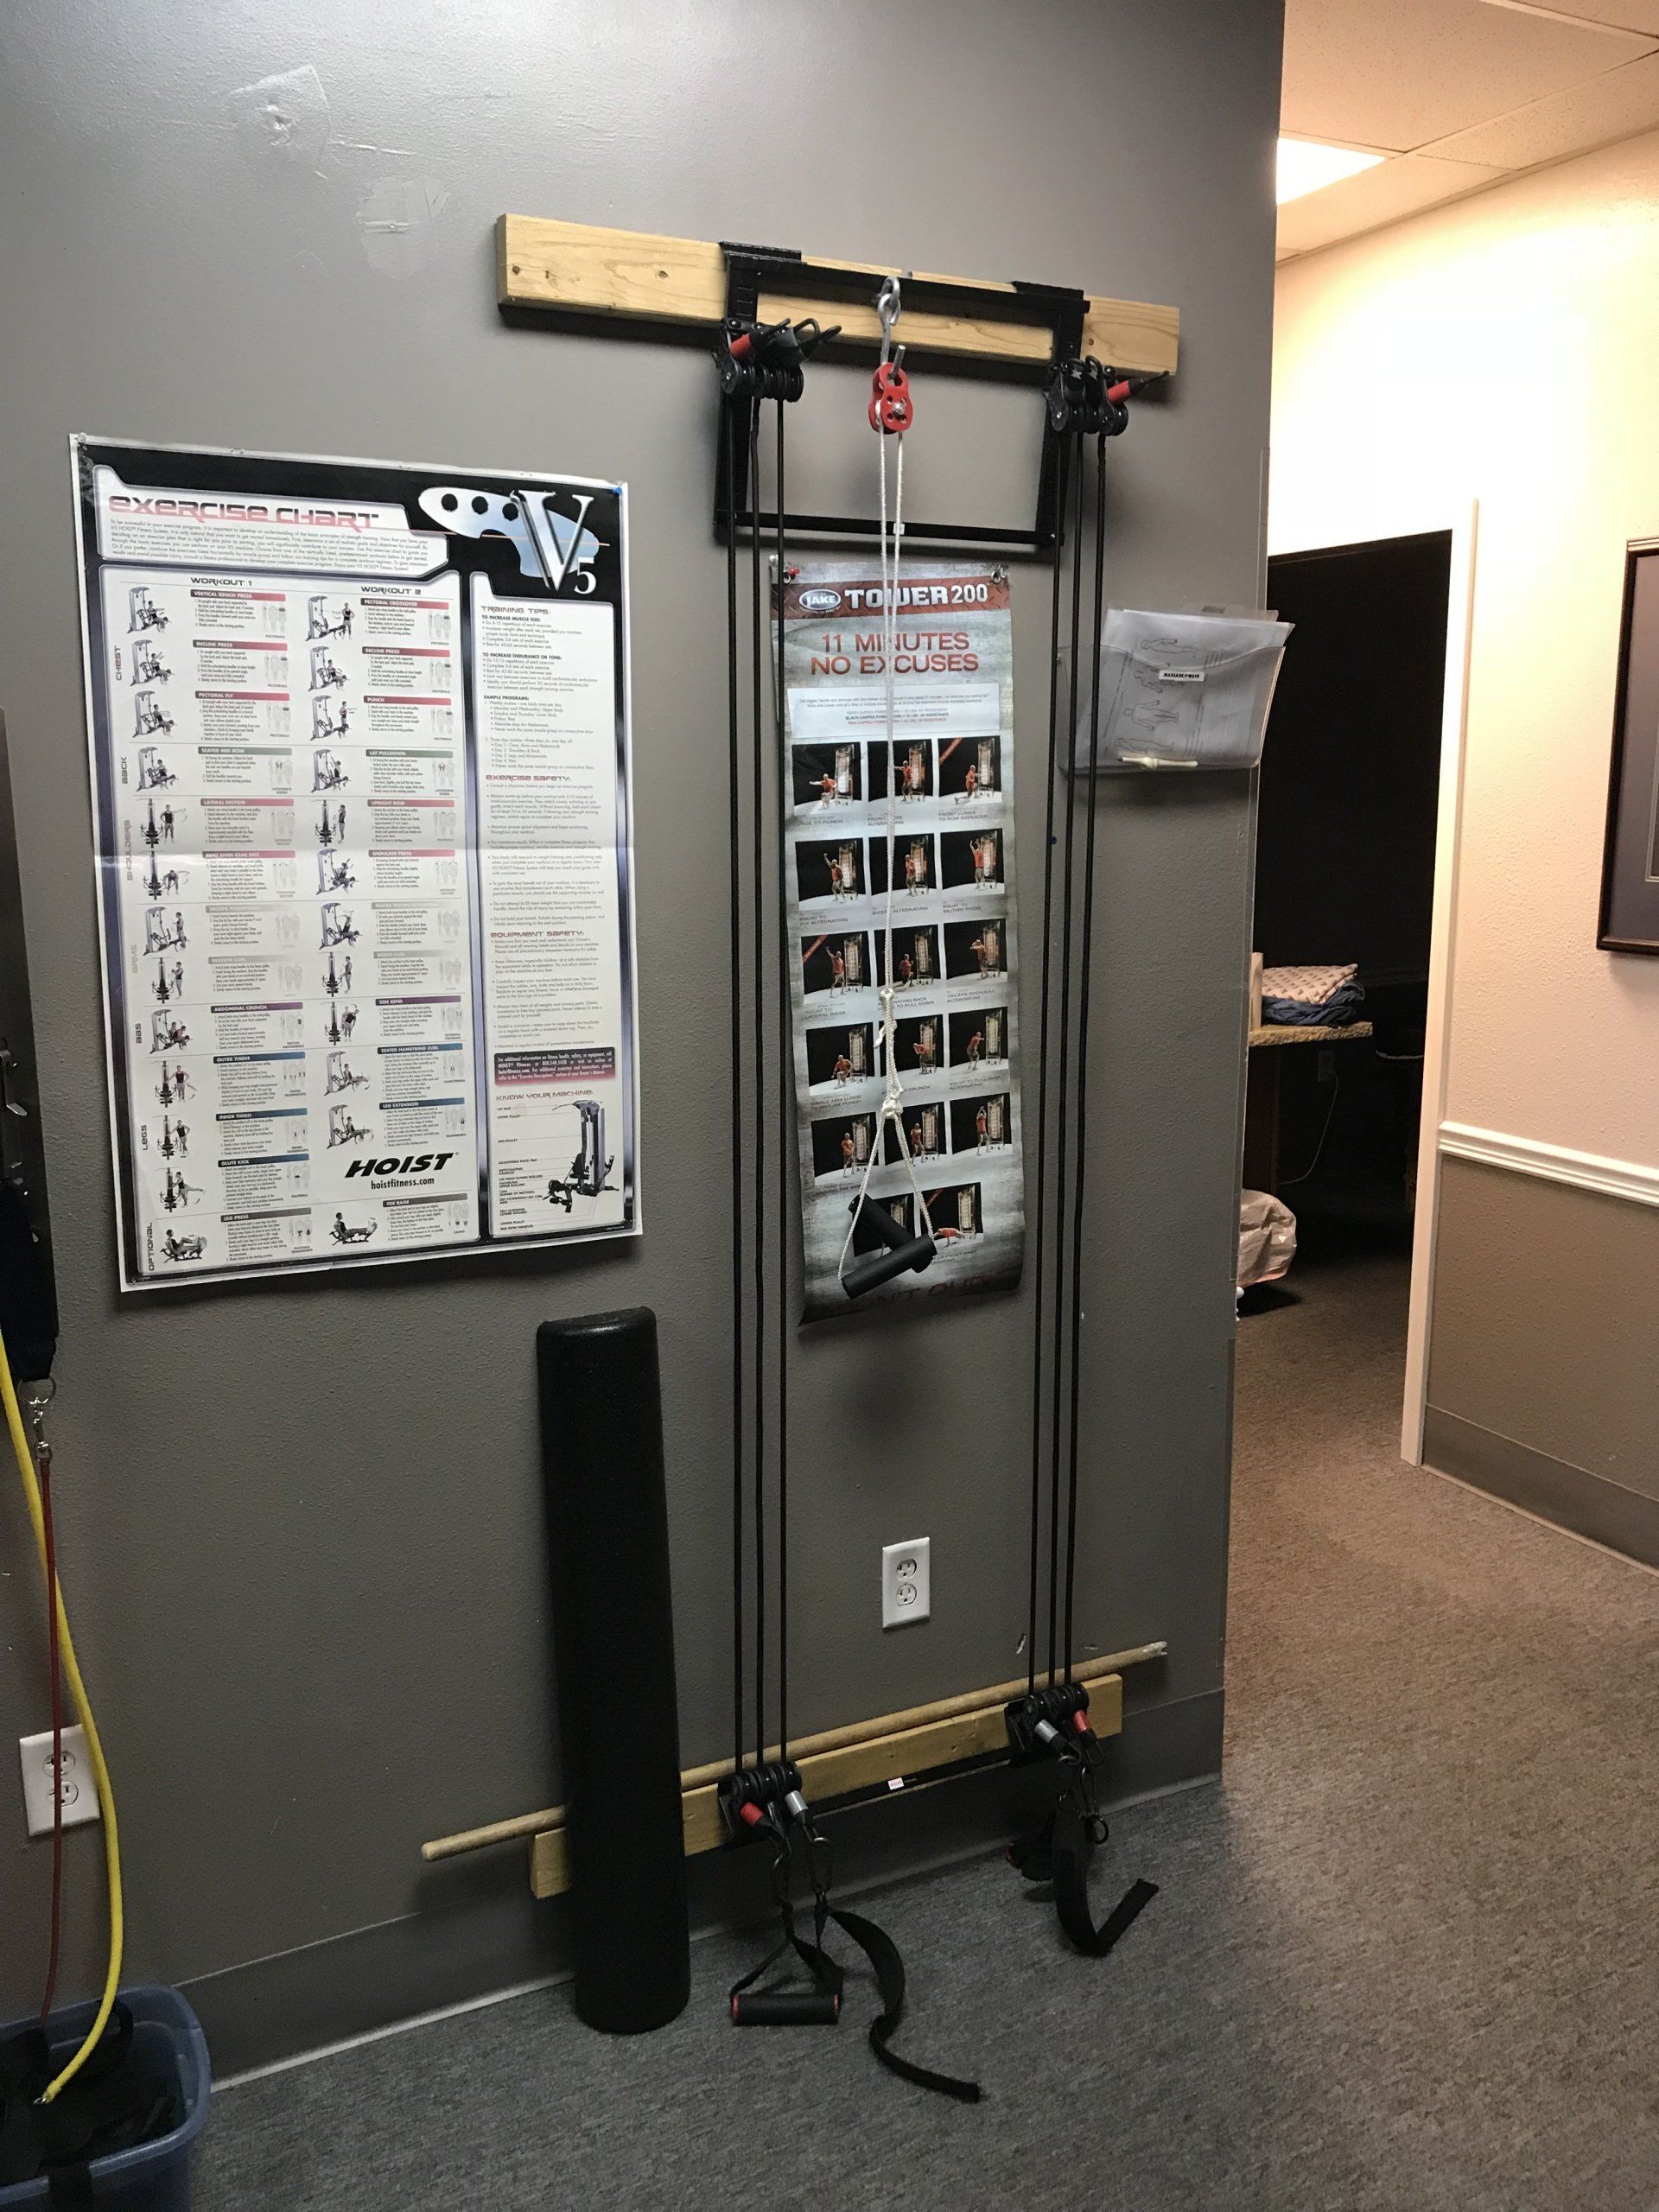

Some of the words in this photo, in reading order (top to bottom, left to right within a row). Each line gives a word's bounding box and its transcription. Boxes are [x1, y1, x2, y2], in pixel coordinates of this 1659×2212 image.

[109, 496, 268, 523] EXERCISE
[276, 508, 378, 533] CHART
[190, 577, 245, 586] WORKOUT
[805, 594, 836, 605] JAKE
[844, 586, 948, 609] TOWER
[951, 583, 988, 603] 200
[481, 606, 524, 614] TRAINING
[822, 634, 842, 652] 11
[855, 632, 969, 652] MINUTES
[810, 657, 851, 675] NO
[345, 1153, 454, 1179] HOIST
[372, 1178, 435, 1190] hoistfitness.com
